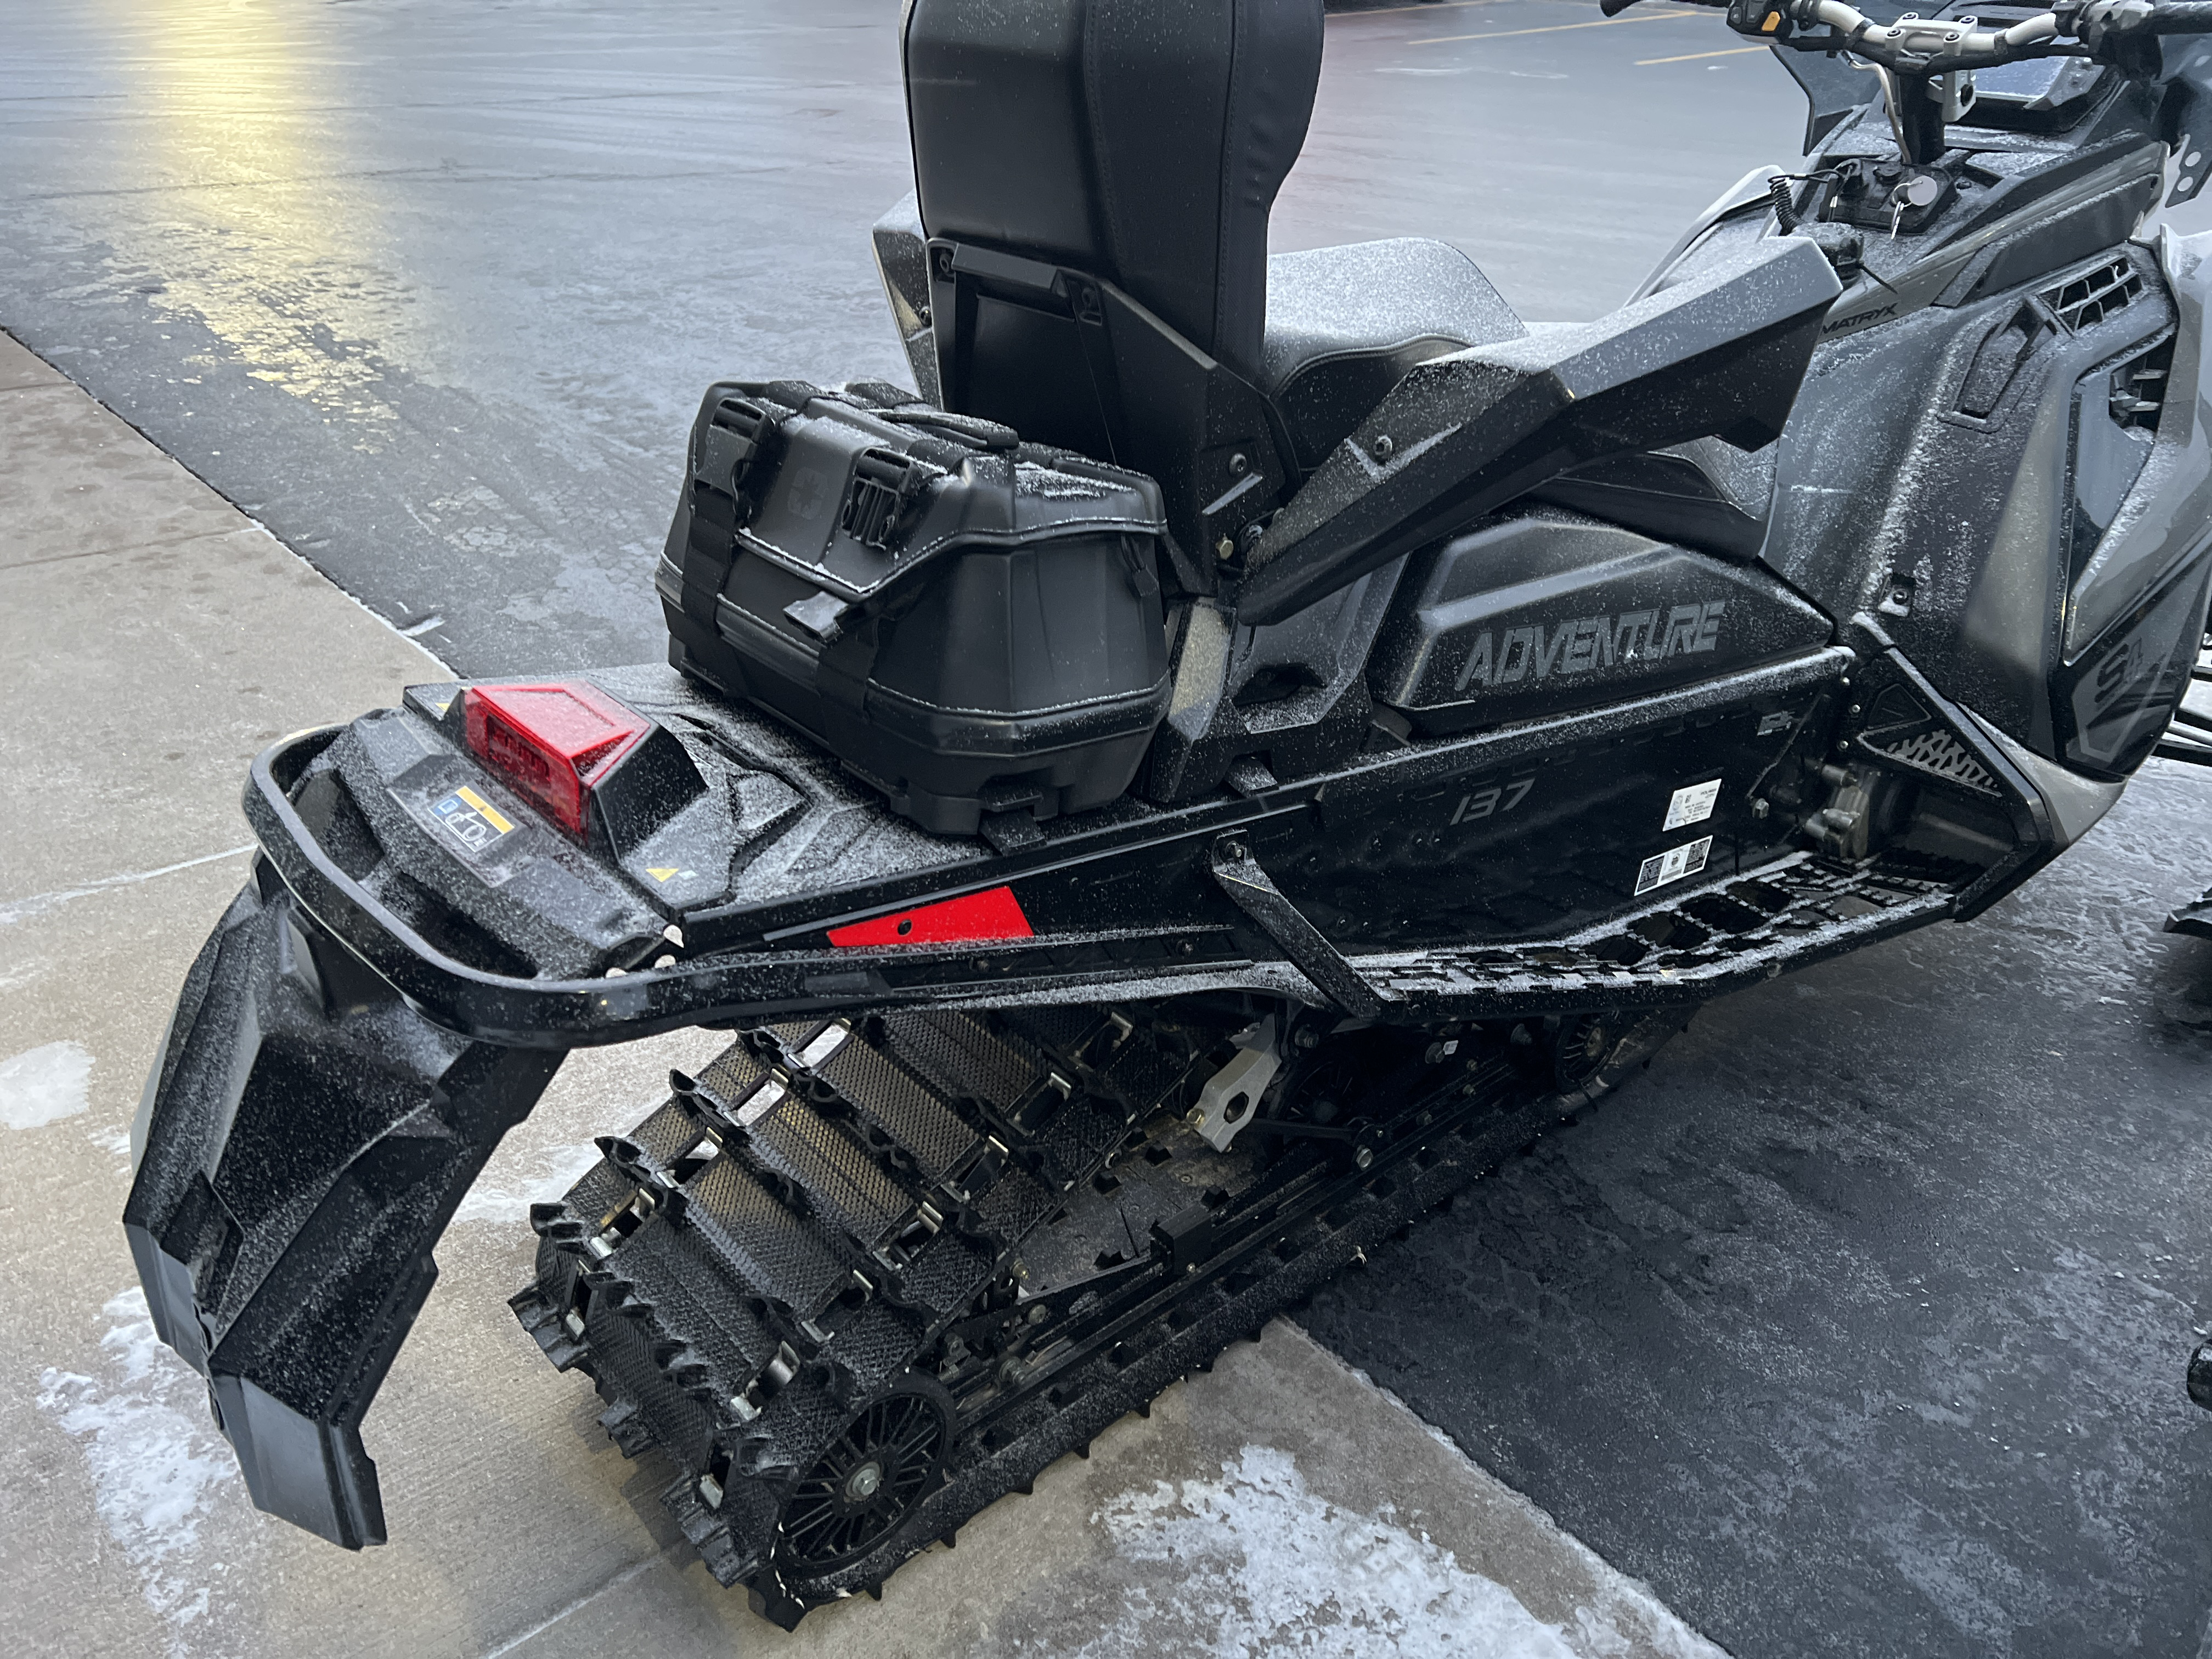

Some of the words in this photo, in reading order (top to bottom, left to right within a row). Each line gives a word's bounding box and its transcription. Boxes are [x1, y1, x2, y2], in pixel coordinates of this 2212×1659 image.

[1822, 302, 1898, 334] MATRYX
[1454, 601, 1725, 692] ADVENTURE
[1449, 777, 1536, 826] 137
